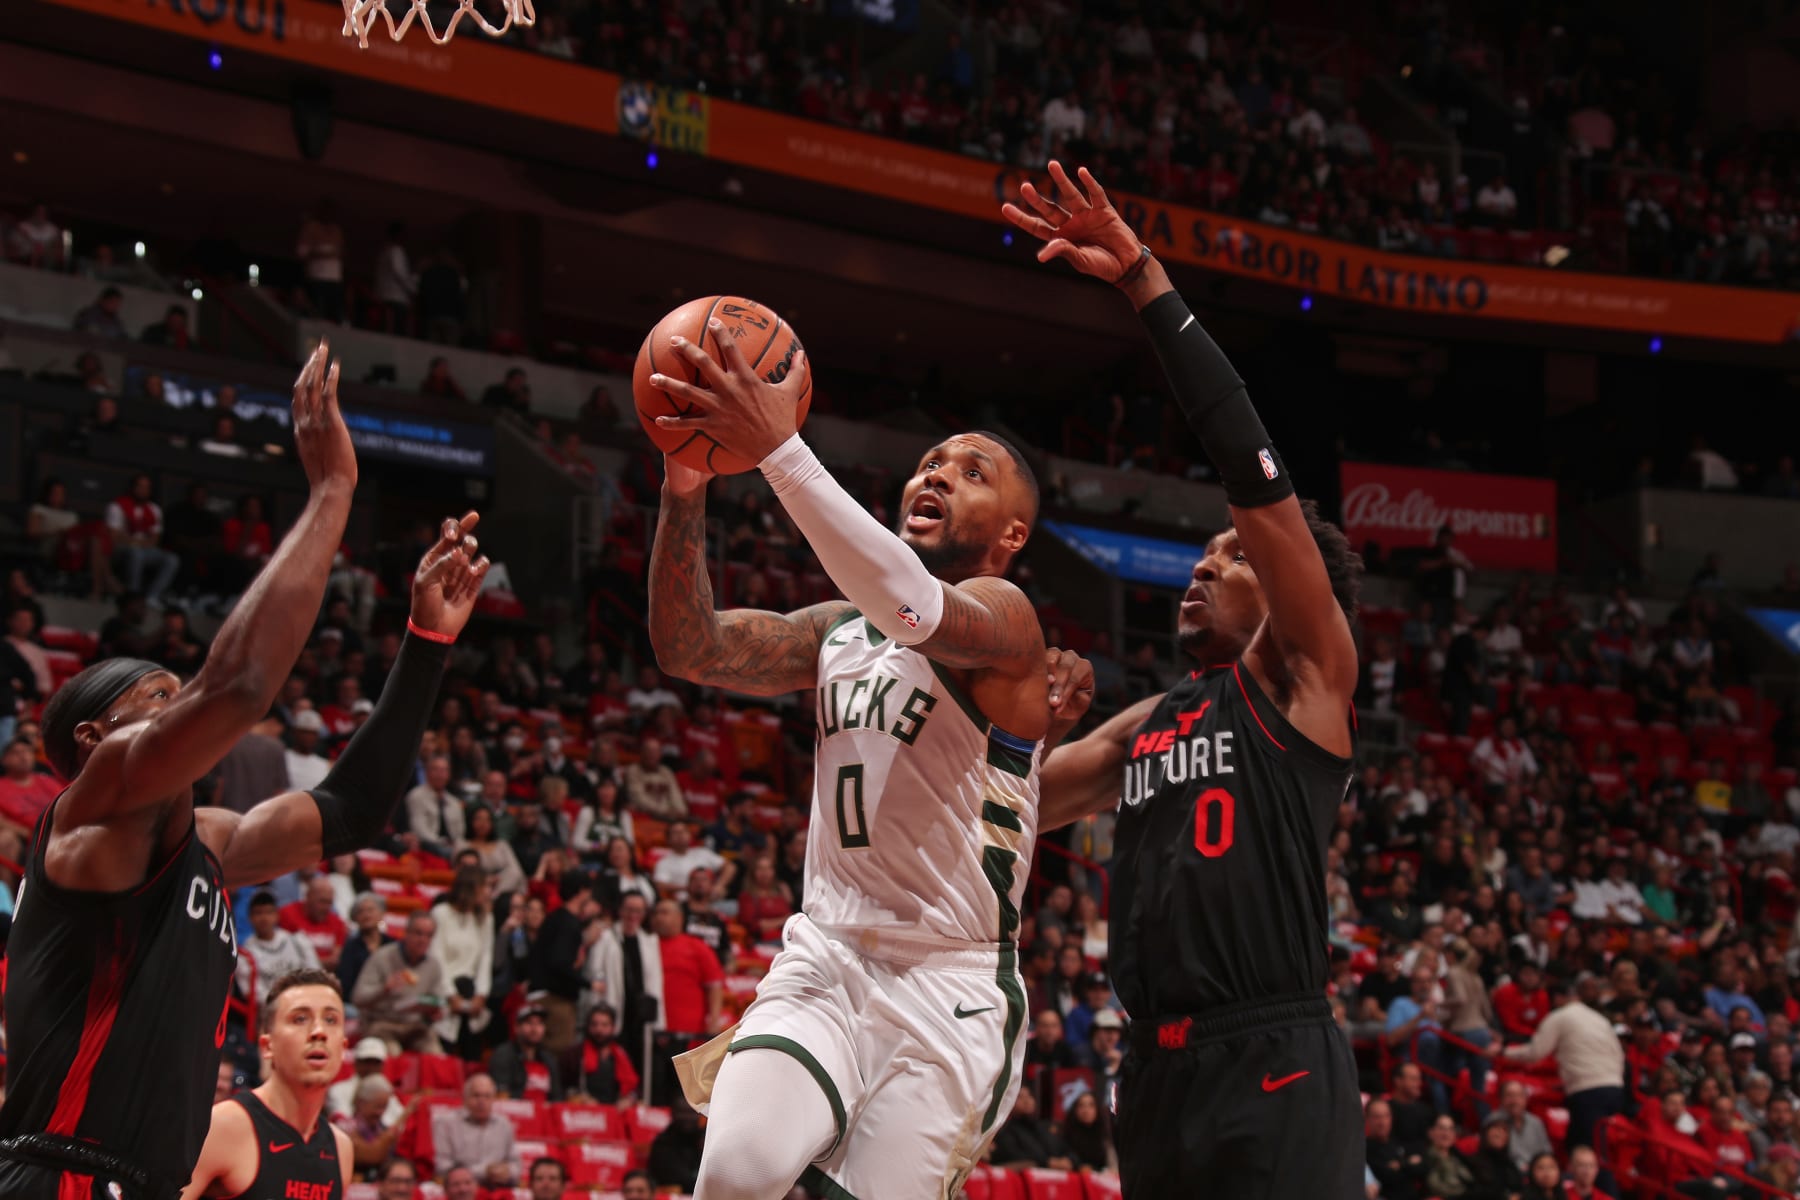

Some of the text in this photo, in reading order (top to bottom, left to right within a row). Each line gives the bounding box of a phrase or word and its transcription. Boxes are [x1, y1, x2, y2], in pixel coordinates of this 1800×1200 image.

[1192, 219, 1488, 311] SABOR LATINO
[1341, 482, 1532, 546] Bally SPORTS
[817, 675, 938, 747] UCKS
[1131, 698, 1212, 760] HET
[836, 763, 870, 849] 0
[1193, 786, 1236, 858] 0
[284, 1178, 334, 1200] HEAT
